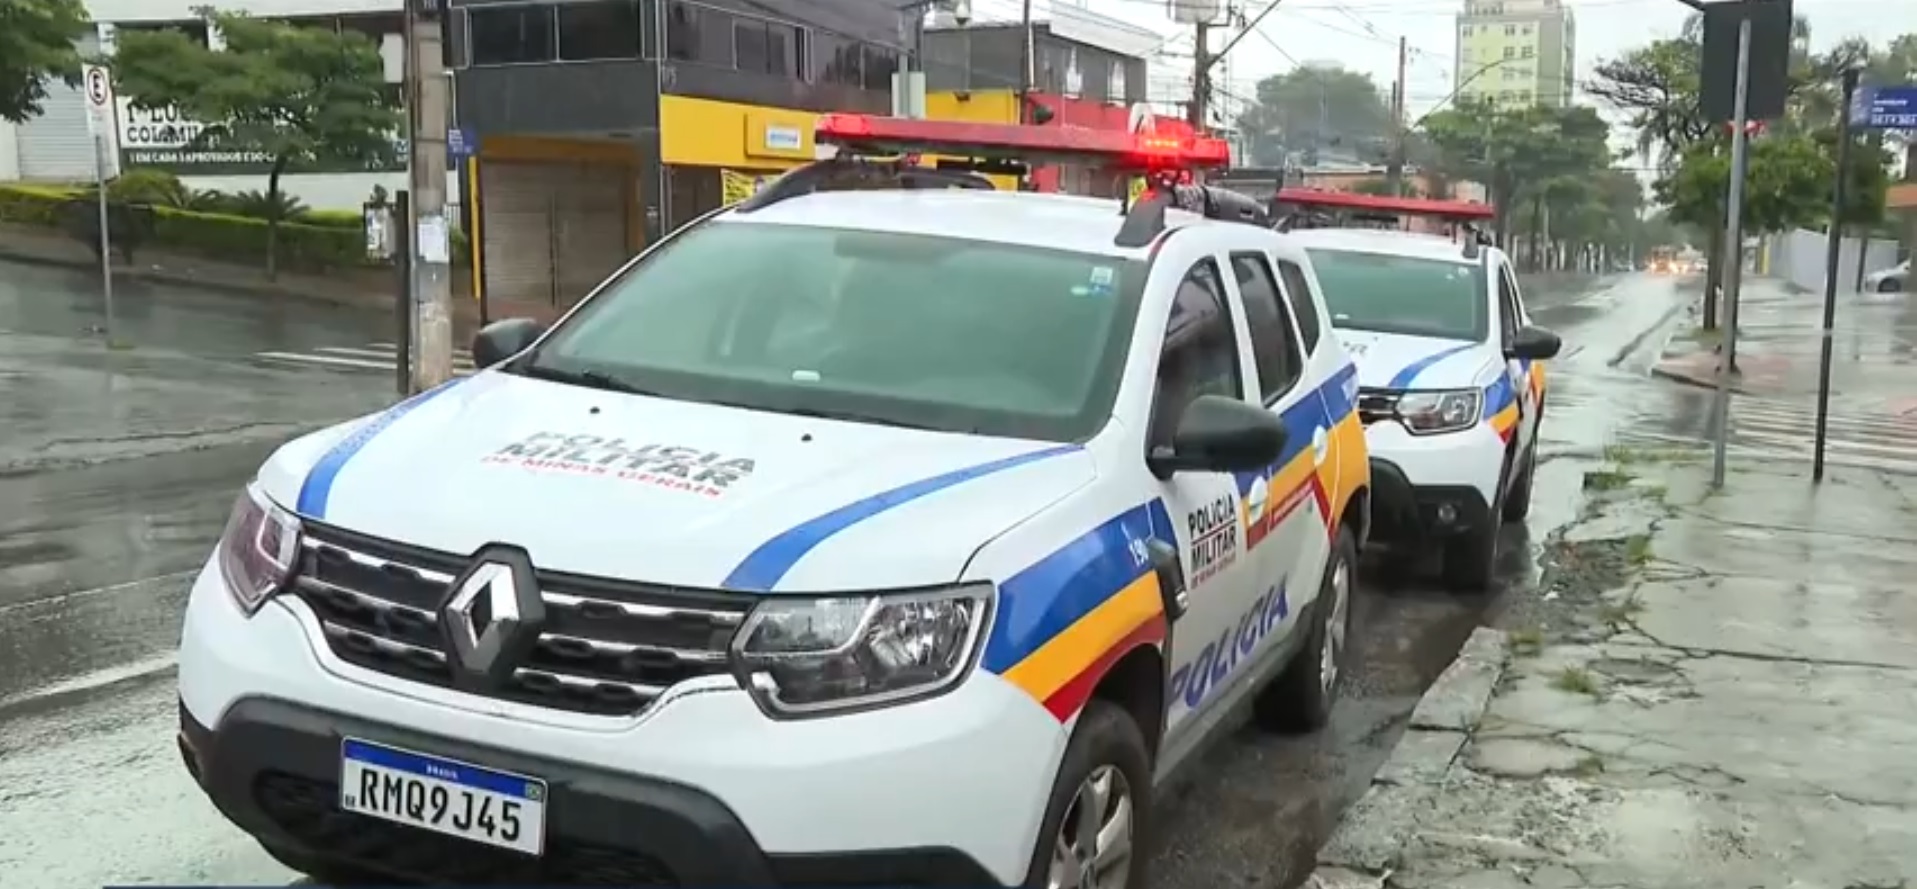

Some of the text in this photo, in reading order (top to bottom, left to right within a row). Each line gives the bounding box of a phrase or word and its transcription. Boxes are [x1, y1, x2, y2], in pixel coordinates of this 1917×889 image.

[495, 442, 738, 487] MILITAR
[522, 458, 606, 474] MINAS
[617, 469, 721, 497] GERAIS
[1188, 493, 1236, 540] POLICIA
[1191, 525, 1237, 573] MILITAR
[1170, 573, 1289, 708] POLICIA
[360, 767, 522, 842] RMQ9J45
